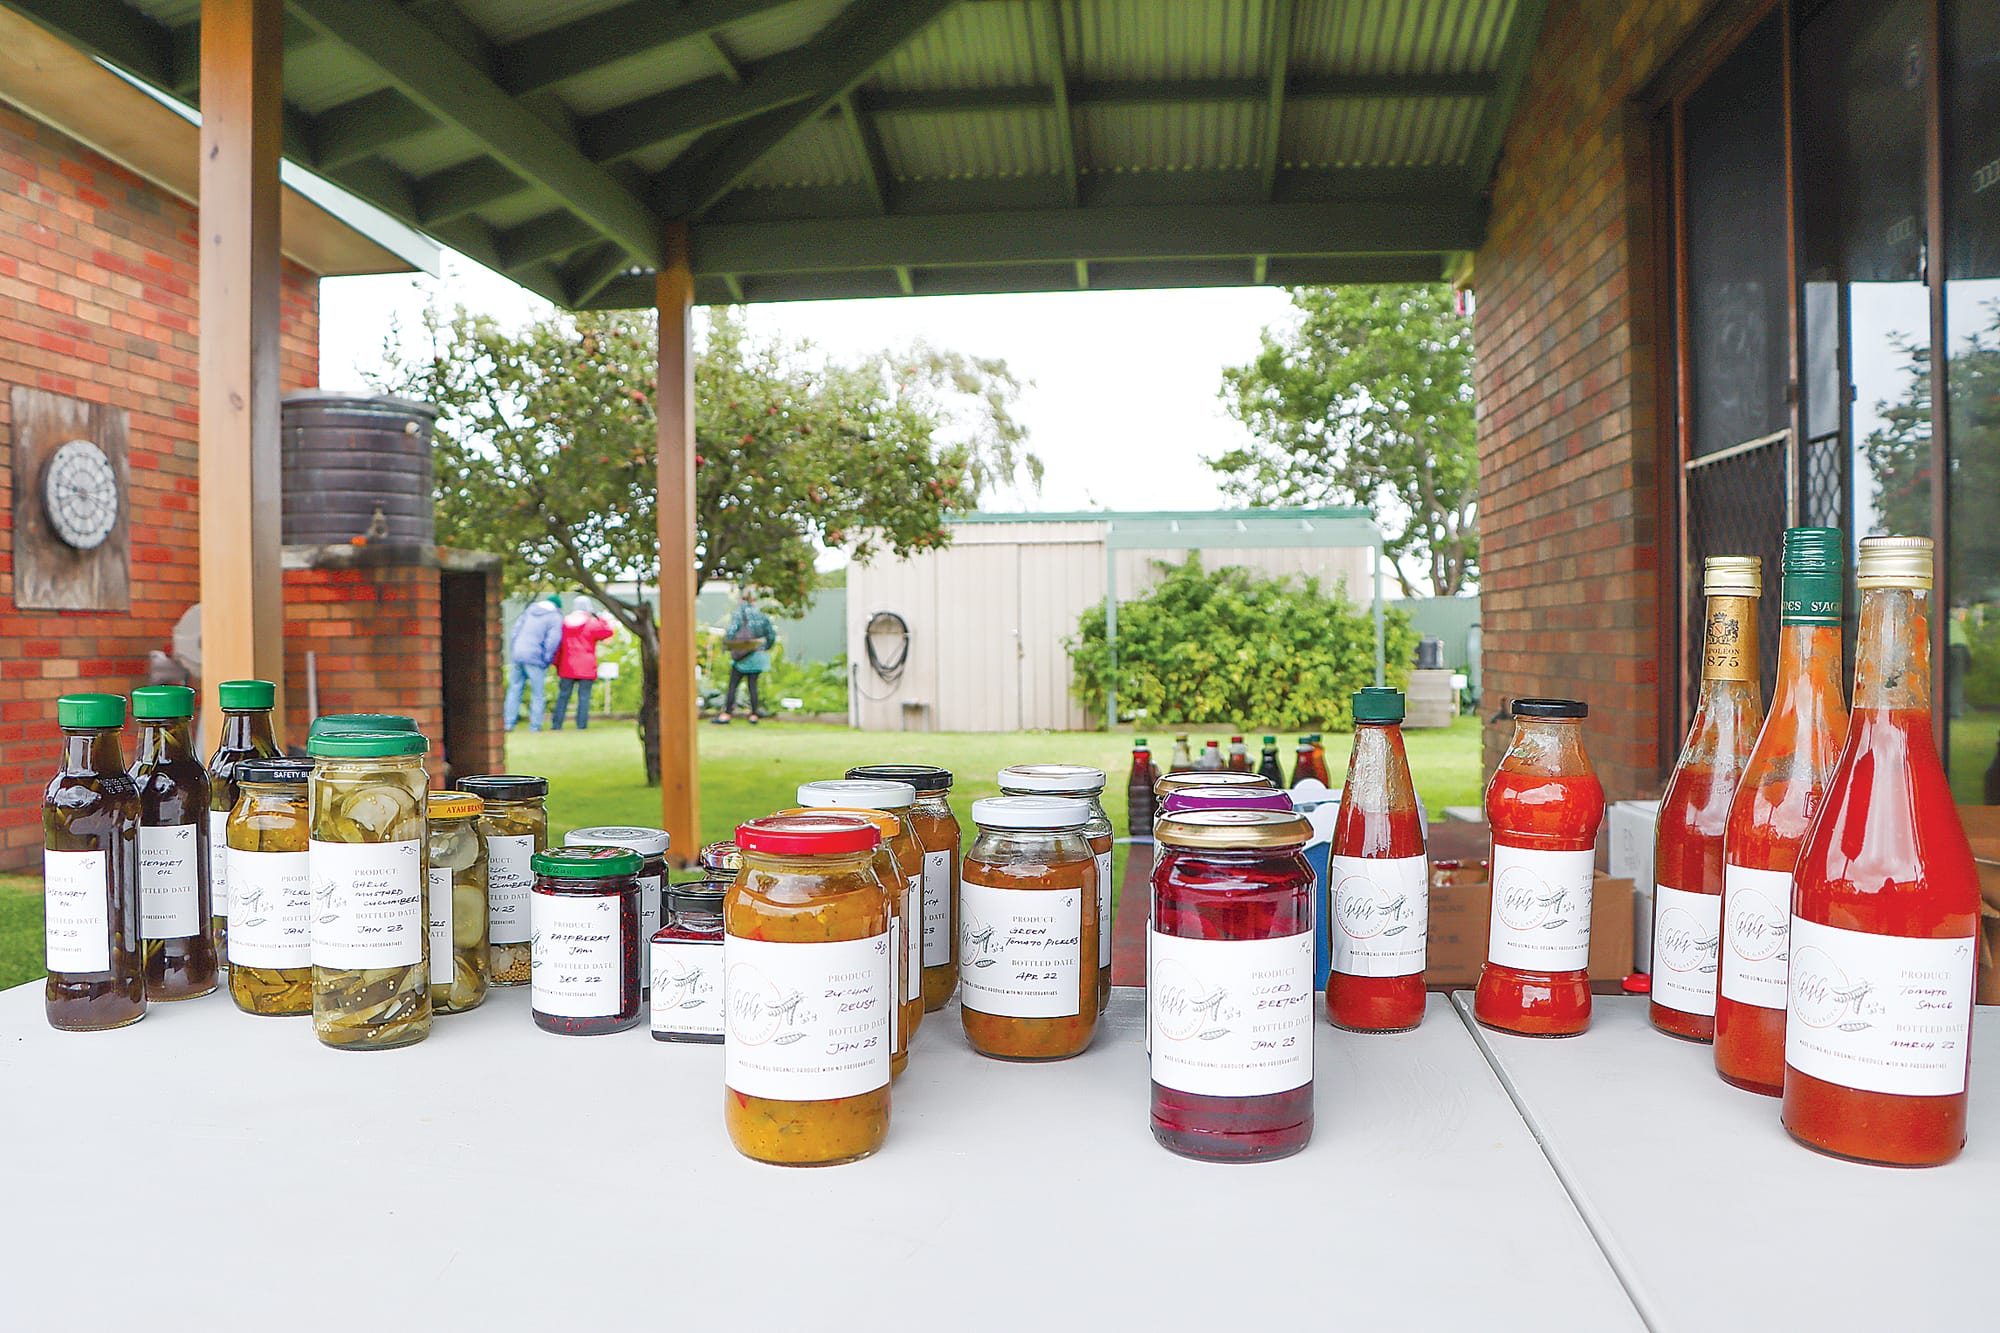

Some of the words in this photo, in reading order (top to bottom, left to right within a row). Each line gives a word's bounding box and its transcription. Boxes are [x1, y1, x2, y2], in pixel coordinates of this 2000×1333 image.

[1704, 655, 1739, 668] 875
[273, 771, 300, 779] SAFETY
[446, 805, 466, 814] AYAM
[502, 904, 516, 913] 23
[355, 910, 396, 920] BOTTLED
[282, 928, 305, 936] JAN
[356, 925, 383, 934] JAN
[386, 923, 405, 933] 23
[1042, 936, 1079, 951] PICKLES
[553, 961, 590, 971] BOTTLED
[1011, 959, 1052, 968] BOTTLED
[1015, 971, 1039, 981] APR
[1043, 972, 1058, 980] 22
[1252, 983, 1292, 996] SLICED
[837, 997, 878, 1015] RELISH
[828, 1022, 870, 1037] BOTTLED
[1252, 1019, 1294, 1033] BOTTLED
[1896, 1023, 1943, 1033] BOTTLED
[825, 1041, 860, 1055] JAN
[863, 1036, 879, 1049] 23
[1889, 1040, 1936, 1051] MARCH
